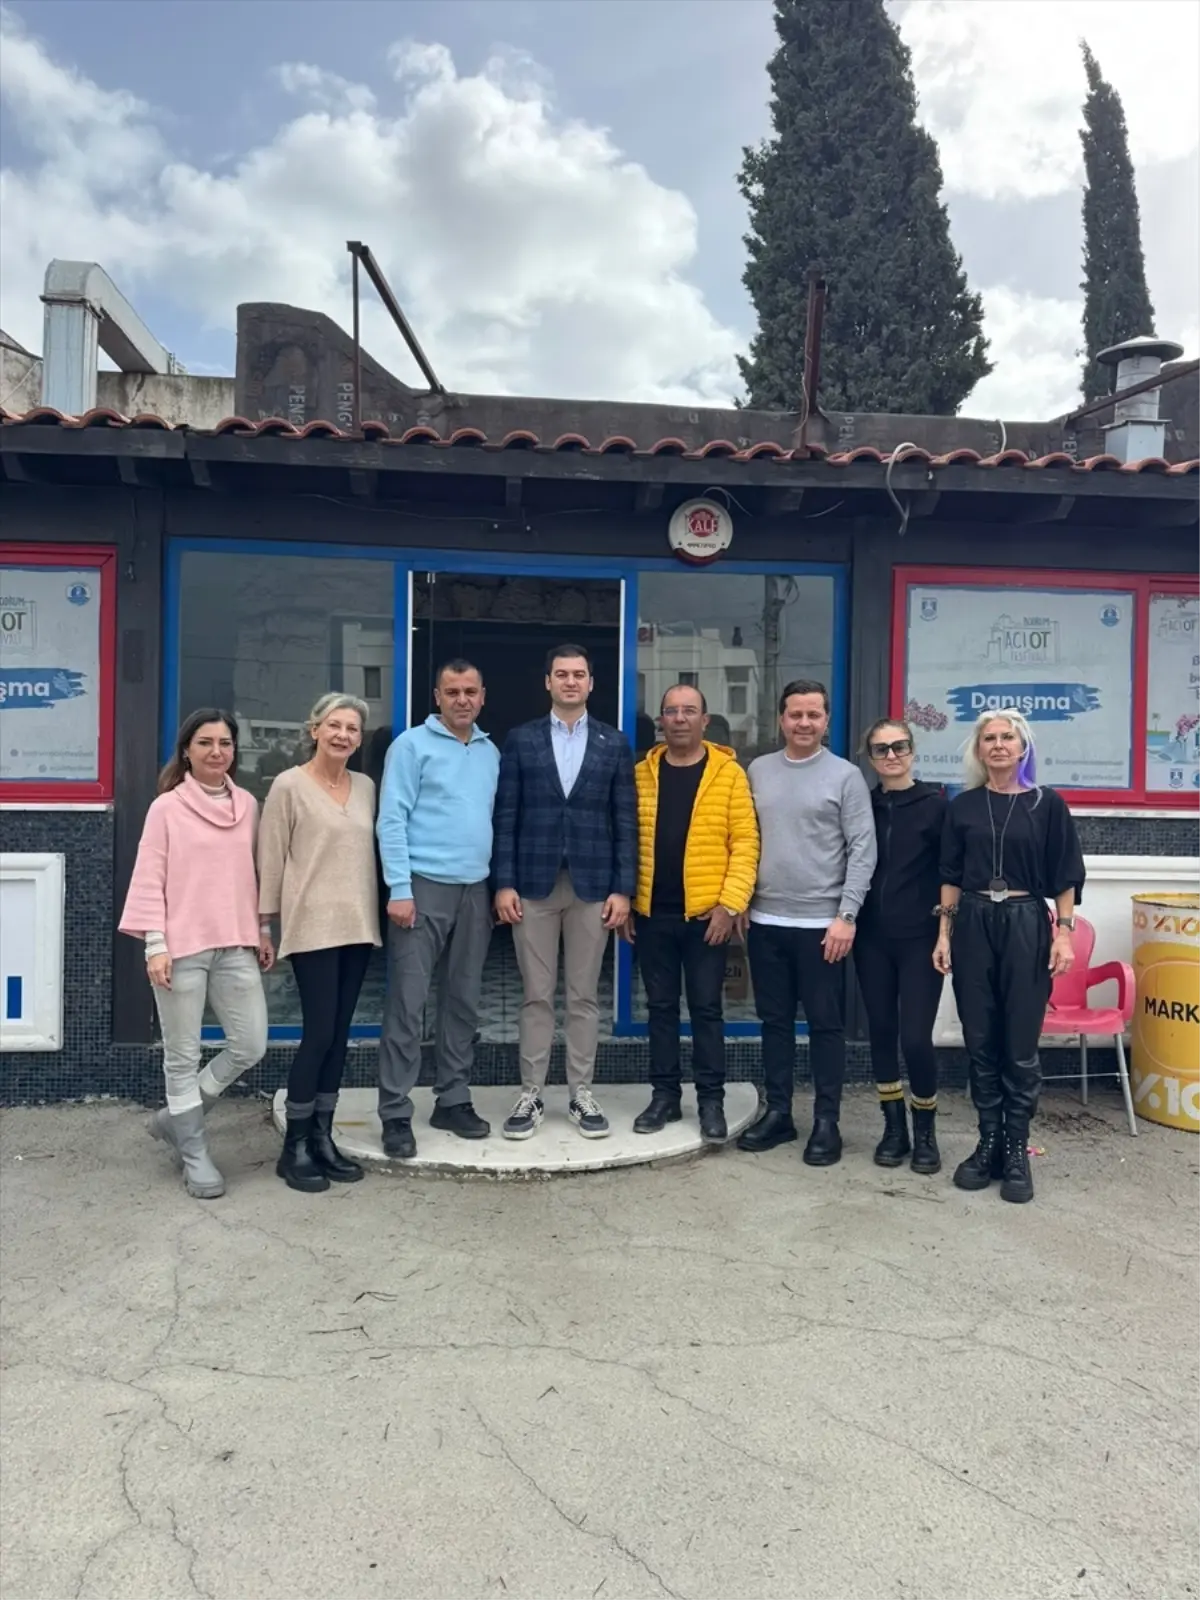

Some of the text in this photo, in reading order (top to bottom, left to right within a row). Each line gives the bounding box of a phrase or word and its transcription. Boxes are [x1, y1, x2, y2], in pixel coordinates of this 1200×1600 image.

[2, 612, 26, 631] OT
[1029, 631, 1051, 649] OT
[971, 692, 1070, 716] Danışma
[1144, 995, 1200, 1024] MARK
